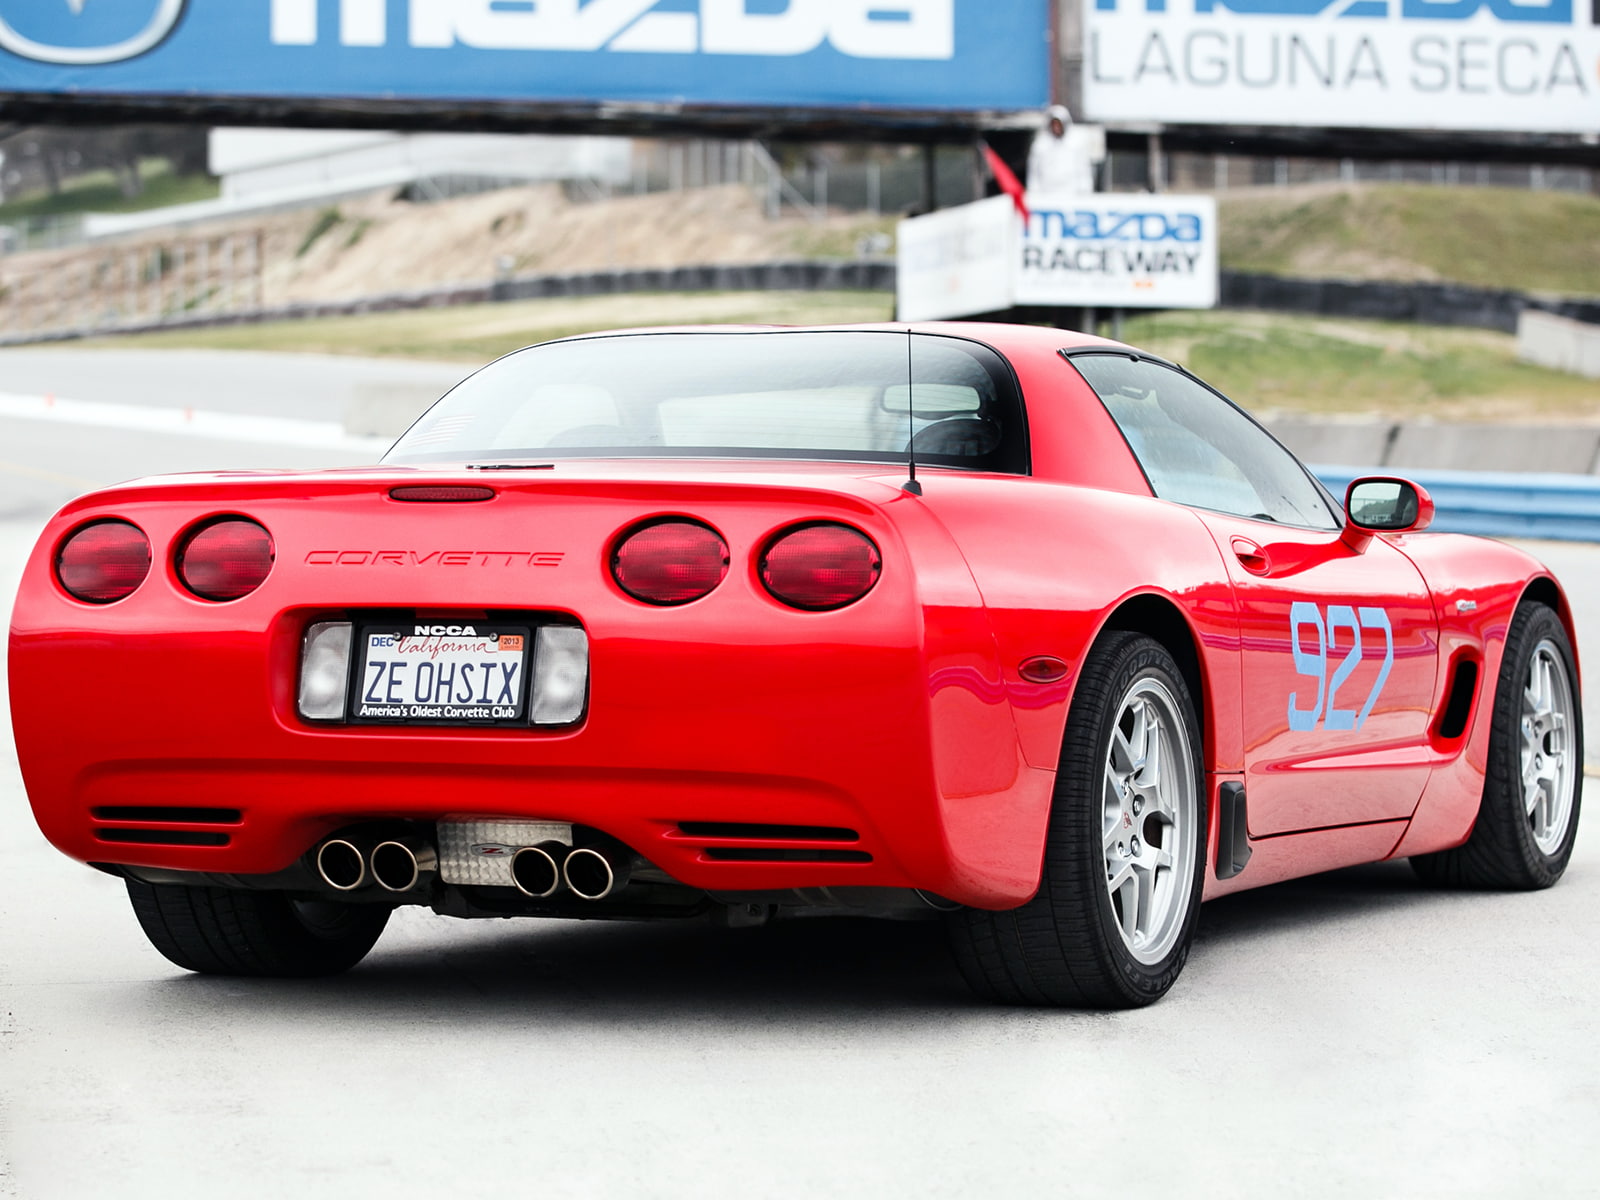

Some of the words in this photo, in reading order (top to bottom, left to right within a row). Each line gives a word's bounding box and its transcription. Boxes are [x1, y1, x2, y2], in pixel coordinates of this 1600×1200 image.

[1090, 28, 1389, 91] LAGUNA
[1410, 34, 1589, 98] SECA
[1024, 209, 1203, 242] mazda
[304, 550, 565, 567] CORVETTE
[414, 625, 477, 637] NCCA
[503, 637, 520, 645] 2013
[371, 636, 394, 647] DEC
[397, 636, 498, 660] California
[1287, 601, 1394, 732] 927
[365, 661, 408, 703] ZE
[359, 704, 408, 718] America's
[410, 705, 441, 717] Oldest
[444, 706, 489, 718] Corvette
[491, 706, 515, 719] Club
